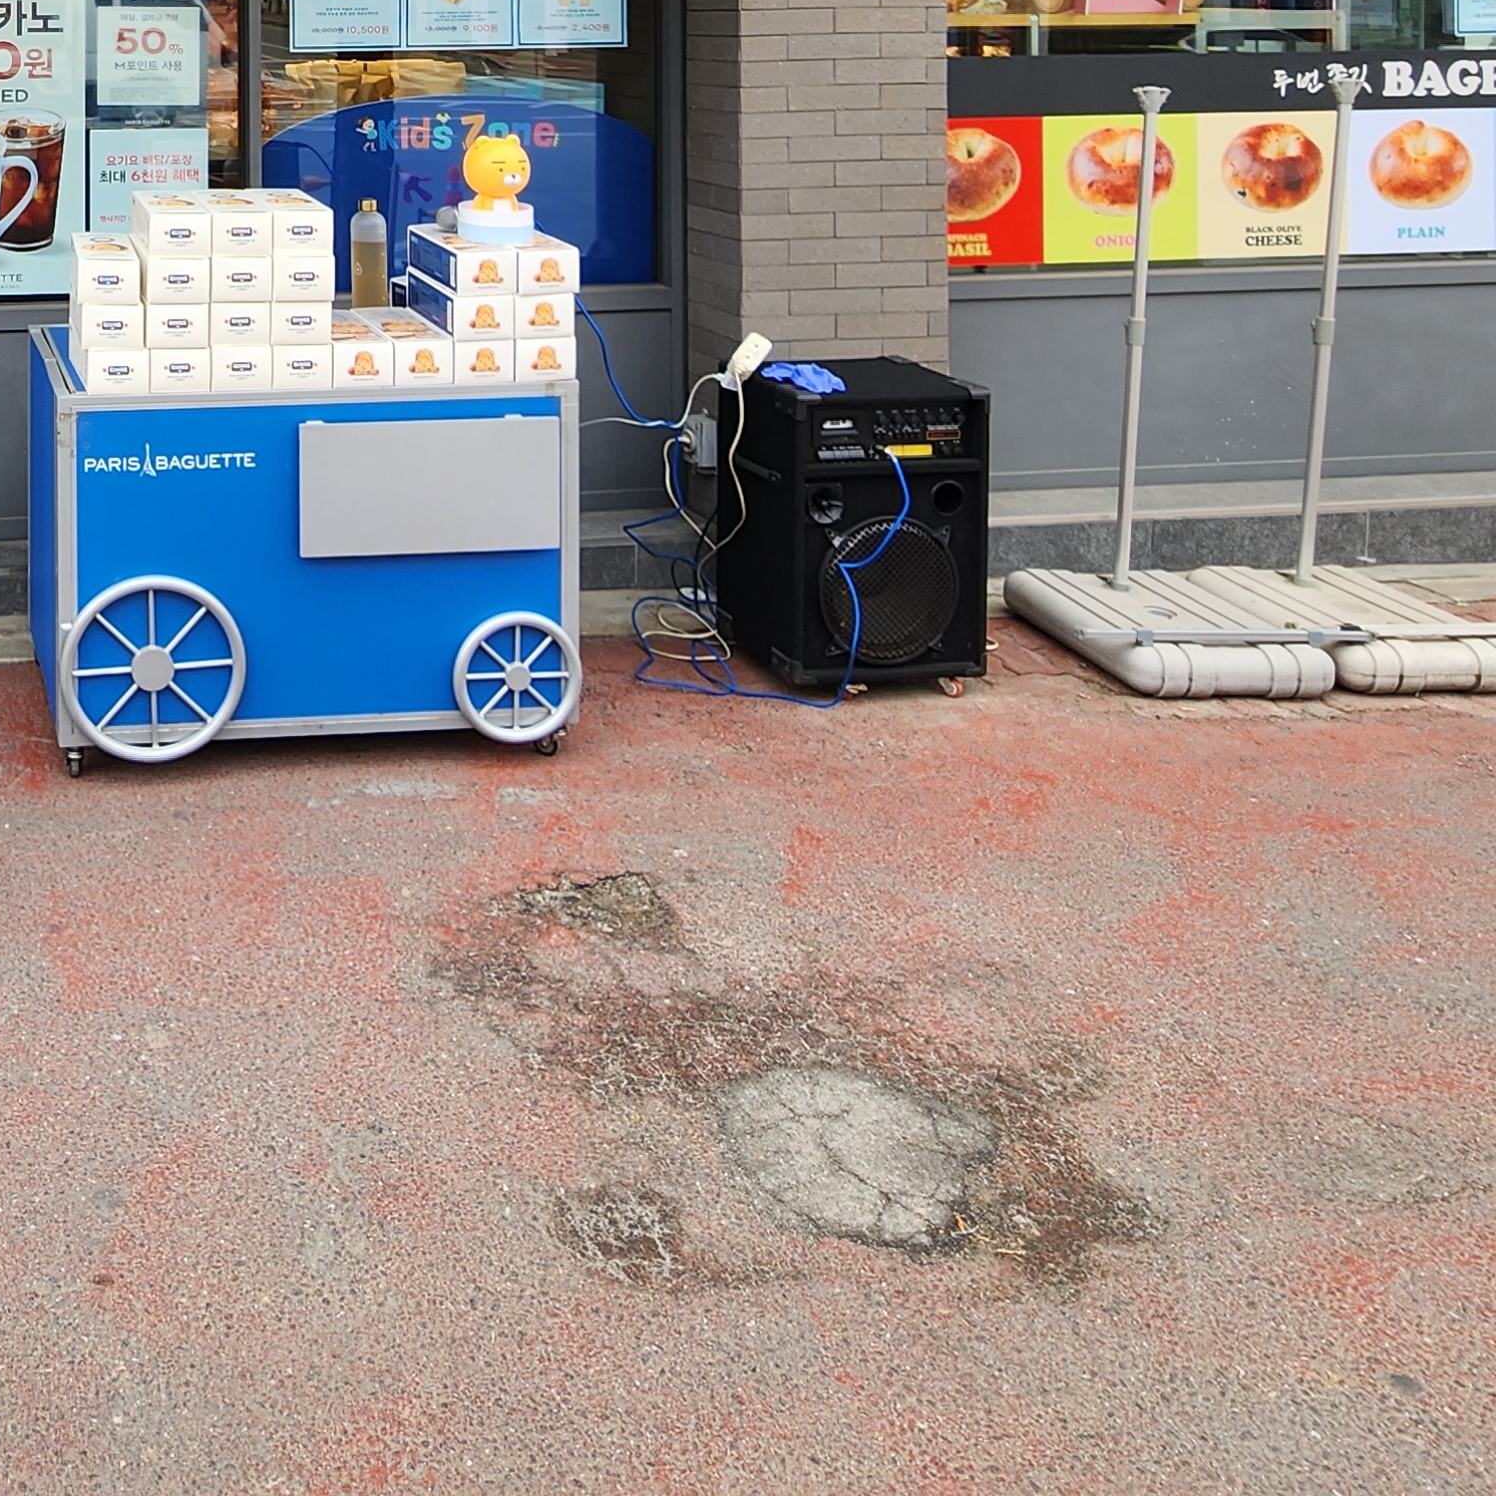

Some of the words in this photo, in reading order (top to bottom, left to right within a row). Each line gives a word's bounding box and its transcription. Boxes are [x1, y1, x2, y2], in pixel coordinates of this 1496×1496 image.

[346, 25, 390, 35] 10,500원
[462, 24, 498, 33] 9,100원
[571, 23, 610, 32] 2,400원
[115, 60, 159, 71] M포인트
[162, 60, 183, 71] 사용
[106, 155, 139, 166] 요기요
[142, 154, 193, 166] 배달/포장
[99, 169, 126, 183] 최대
[131, 169, 167, 184] 6천원
[172, 168, 201, 183] 혜택
[1245, 225, 1274, 234] BLACK
[1276, 225, 1302, 233] OLIVE
[1397, 226, 1446, 239] PLAIN
[1245, 234, 1302, 247] CHEESE
[84, 456, 140, 473] PARIS
[155, 452, 256, 471] BAGUETTE
